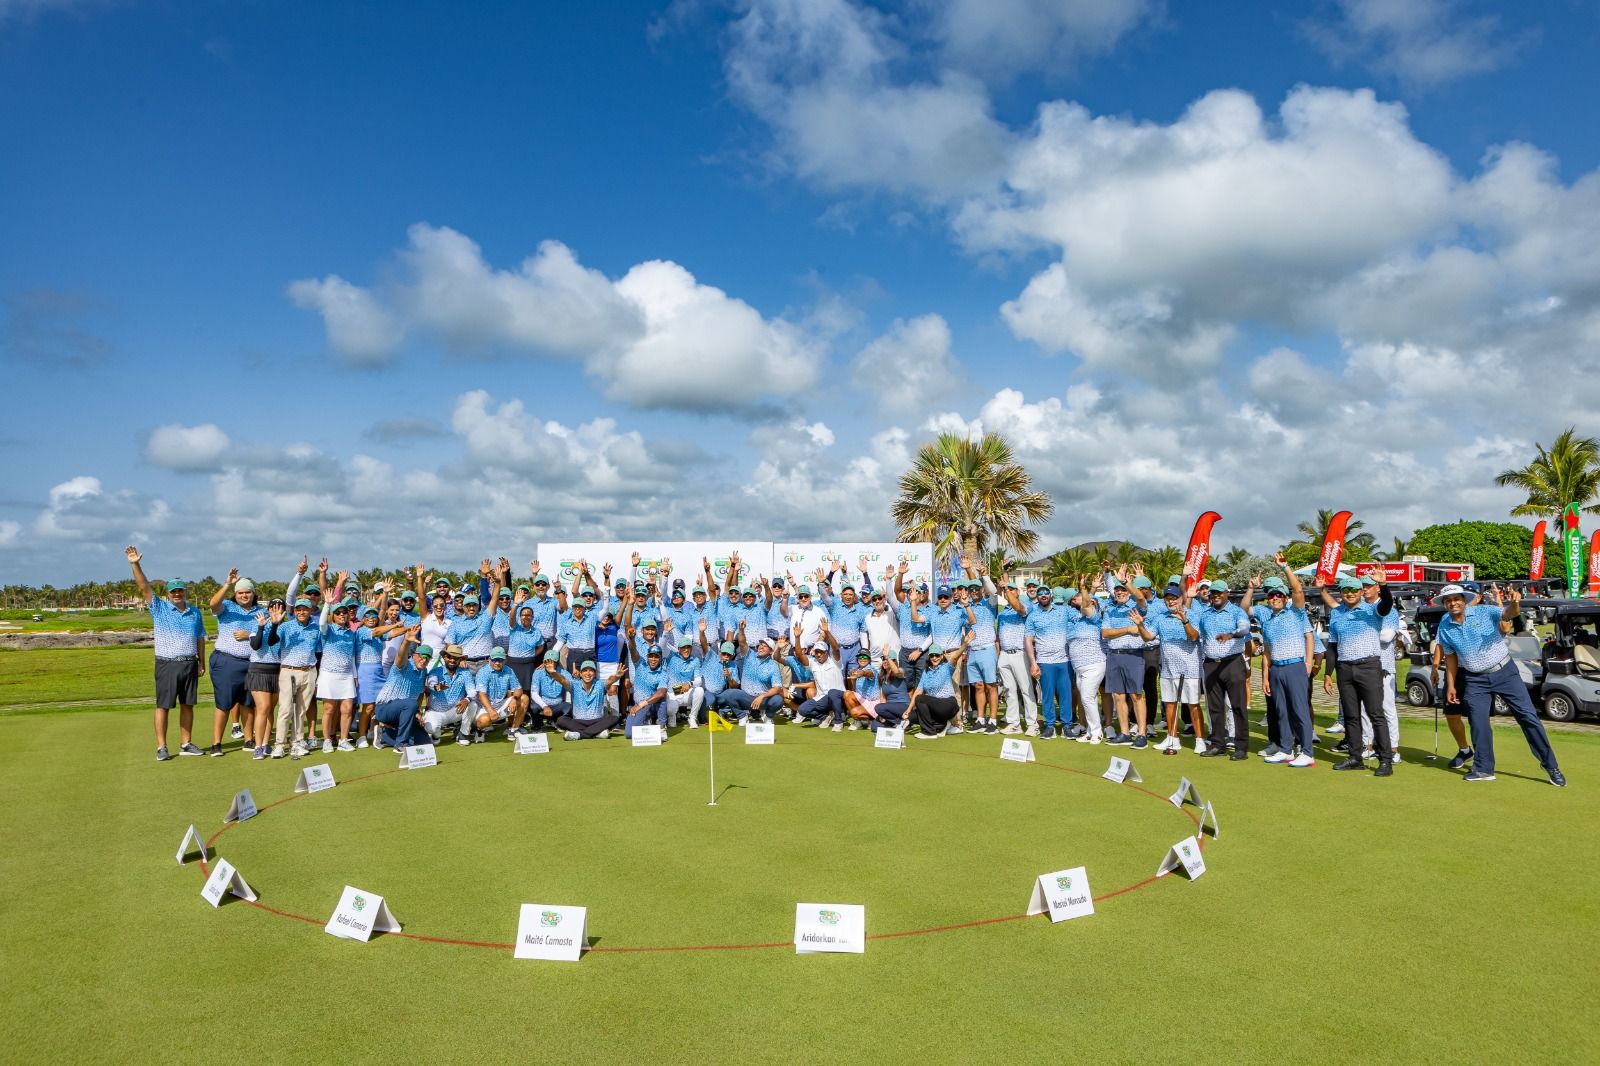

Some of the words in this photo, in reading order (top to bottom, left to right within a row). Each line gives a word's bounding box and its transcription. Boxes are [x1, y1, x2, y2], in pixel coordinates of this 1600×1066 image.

[1325, 539, 1342, 575] Domingo
[1570, 537, 1580, 597] Heineken
[335, 913, 352, 926] Rafael
[524, 933, 544, 945] Maité
